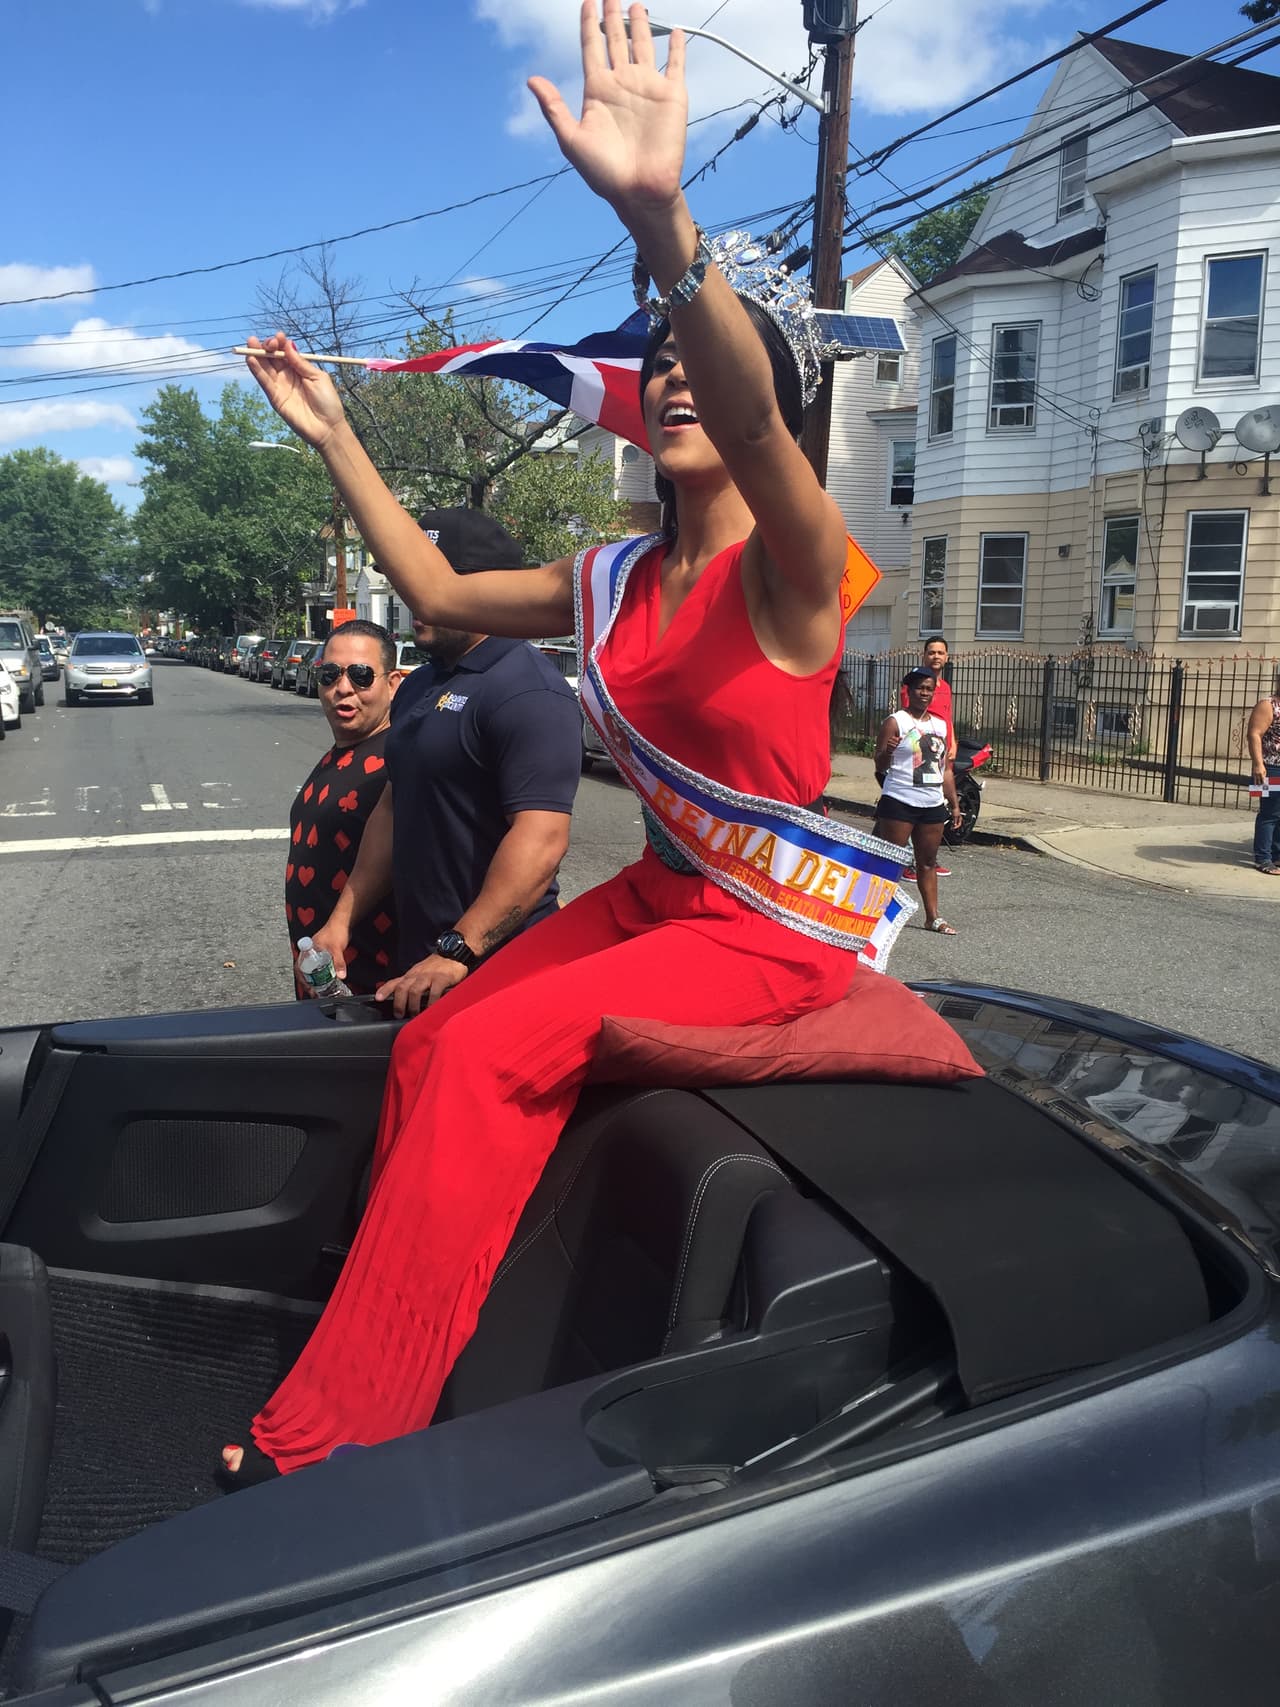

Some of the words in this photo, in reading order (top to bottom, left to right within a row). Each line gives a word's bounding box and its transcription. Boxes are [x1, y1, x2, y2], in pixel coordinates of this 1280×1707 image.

[653, 780, 778, 875] REINA
[783, 848, 861, 913] DEL
[727, 861, 775, 899] FESTIVAL
[776, 889, 822, 923] ESTATAL
